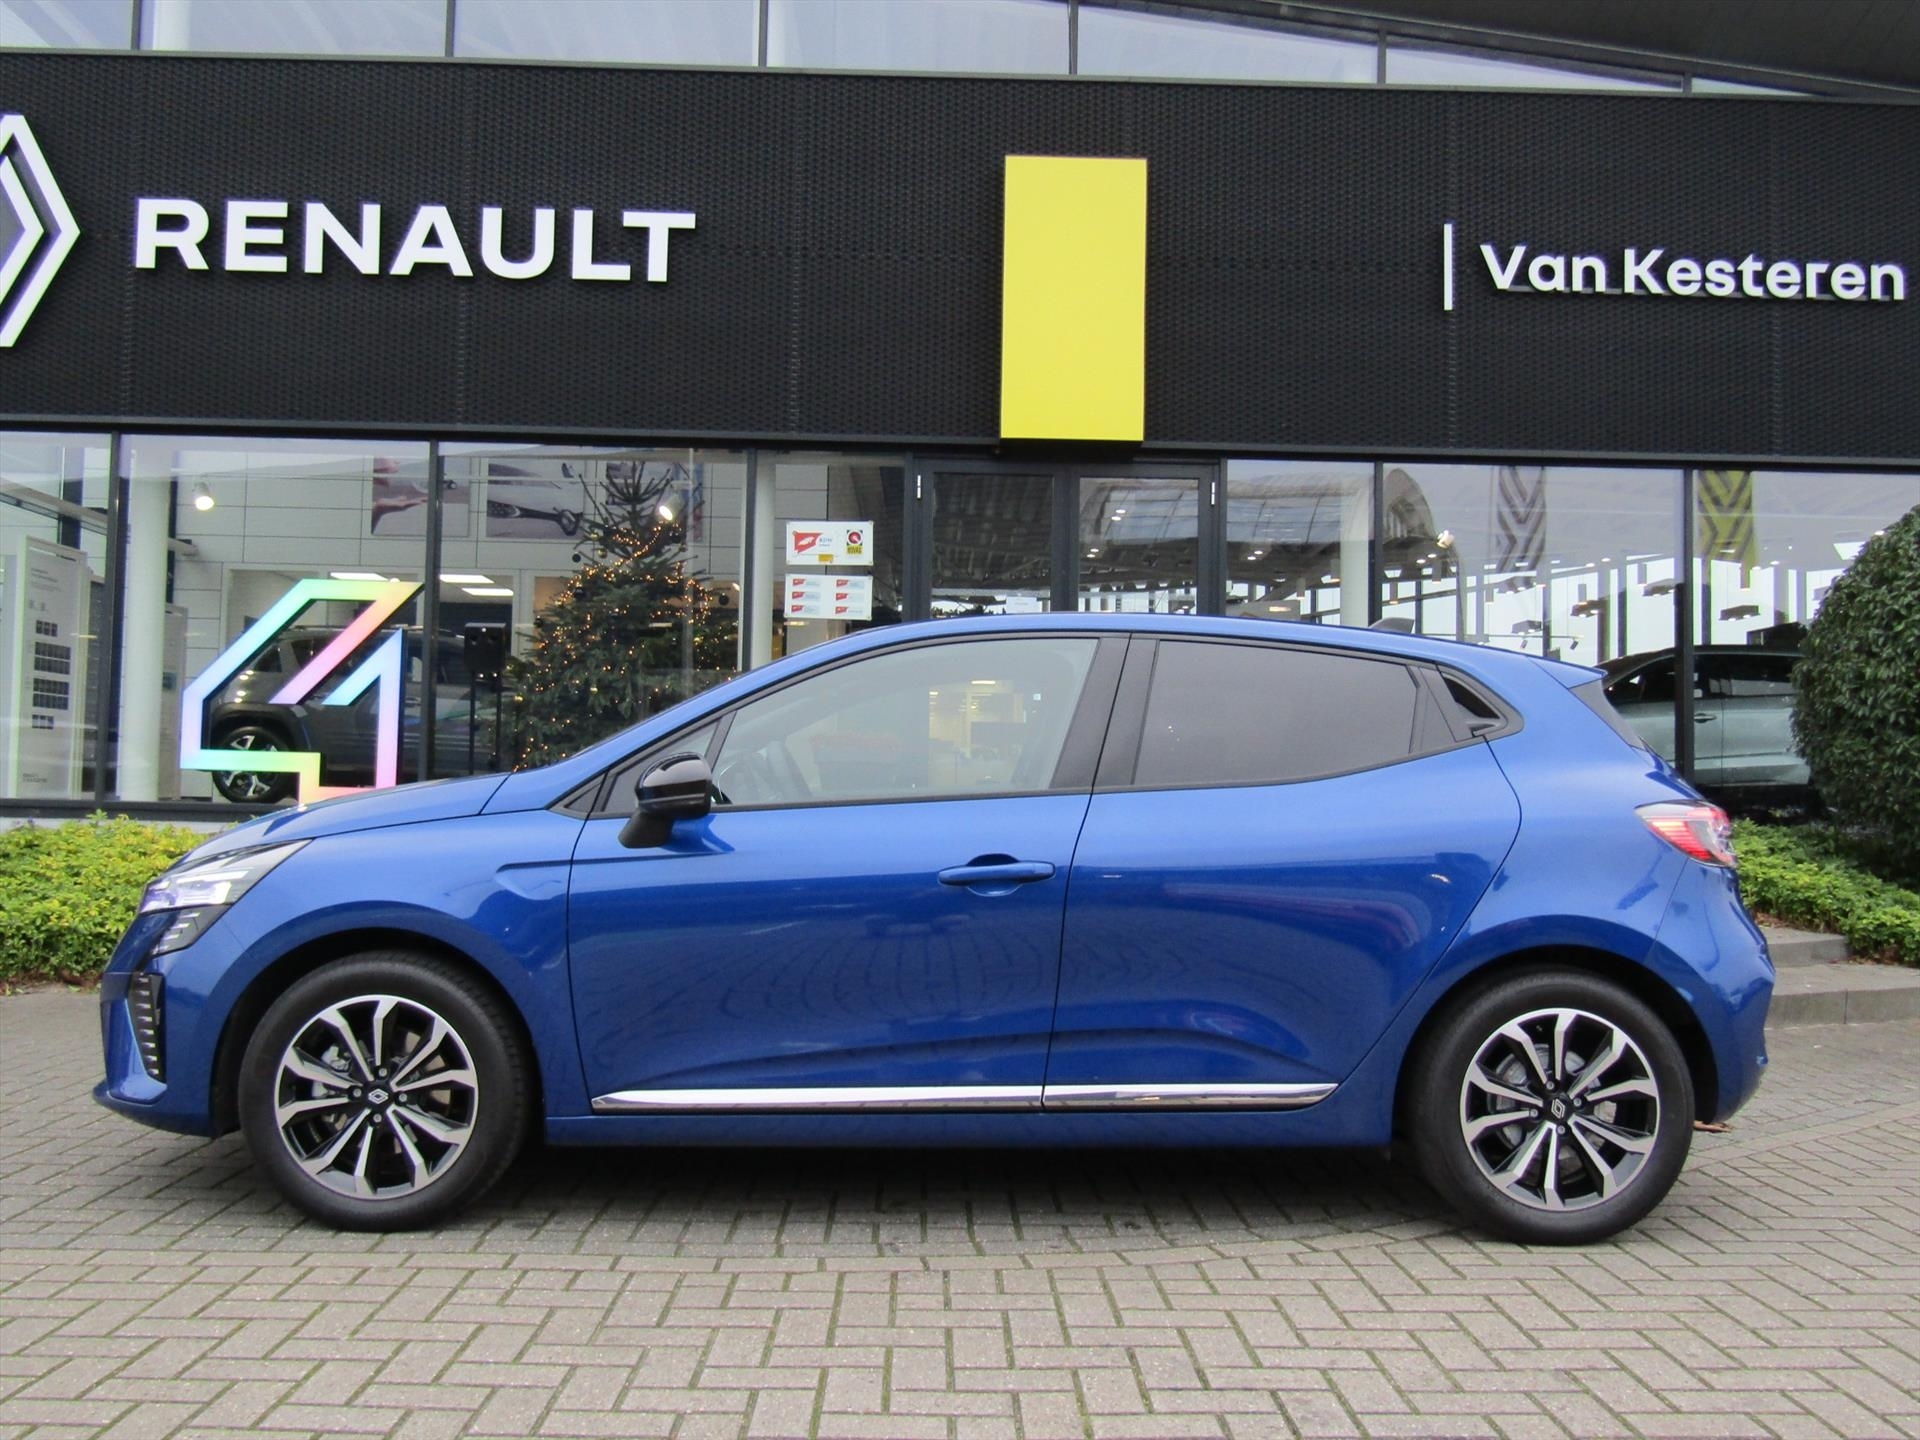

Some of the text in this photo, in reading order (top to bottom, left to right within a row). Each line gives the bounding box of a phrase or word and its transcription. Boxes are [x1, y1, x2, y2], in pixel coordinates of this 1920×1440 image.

[135, 198, 696, 282] RENAULT
[1479, 244, 1905, 300] Van Kesteren
